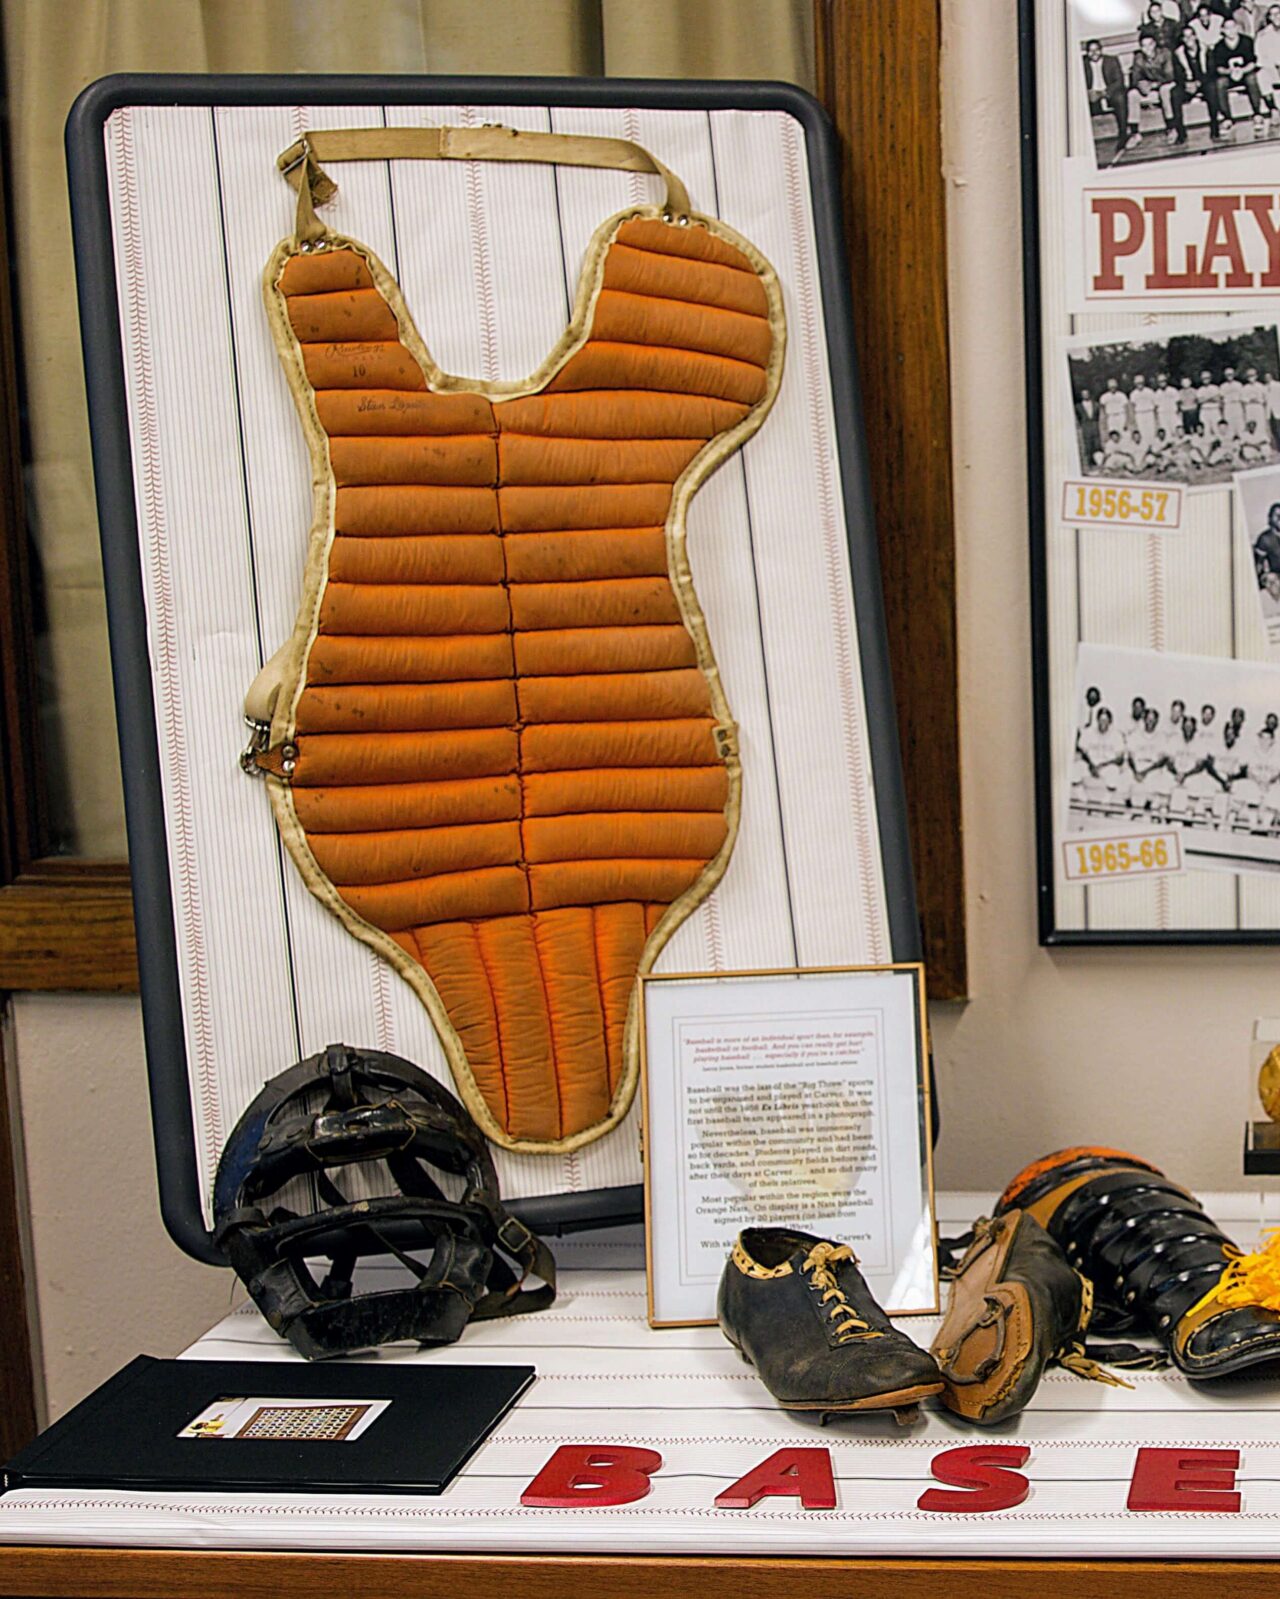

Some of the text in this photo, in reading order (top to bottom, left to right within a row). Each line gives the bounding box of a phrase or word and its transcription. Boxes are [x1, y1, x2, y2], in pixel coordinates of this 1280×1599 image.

[1075, 487, 1168, 522] 1956-57
[1077, 839, 1169, 875] 1965-66
[687, 1085, 722, 1093] Baseball
[848, 1077, 874, 1088] sports
[774, 1091, 802, 1101] played
[724, 1104, 737, 1112] the
[801, 1100, 839, 1110] yearbook
[705, 1116, 742, 1124] baseball
[743, 1114, 764, 1122] team
[766, 1112, 806, 1123] appeared
[760, 1126, 796, 1134] baseball
[816, 1122, 861, 1133] immensely
[691, 1140, 723, 1150] popular
[726, 1138, 751, 1146] within
[768, 1135, 815, 1146] community
[852, 1132, 872, 1140] been
[792, 1145, 821, 1156] played
[690, 1161, 710, 1169] back
[757, 1157, 803, 1168] community
[805, 1155, 829, 1163] fields
[830, 1154, 858, 1162] before
[732, 1170, 752, 1180] days
[763, 1168, 792, 1176] Carver
[810, 1166, 825, 1174] and
[854, 1165, 878, 1174] many
[702, 1195, 721, 1203] Most
[724, 1194, 756, 1204] popular
[758, 1192, 784, 1200] within
[802, 1189, 829, 1200] region
[852, 1187, 866, 1195] the
[696, 1206, 727, 1216] Orange
[768, 1202, 799, 1213] display
[817, 1200, 836, 1208] Nats
[837, 1199, 873, 1207] baseball
[714, 1215, 742, 1225] signed
[744, 1214, 755, 1224] by
[769, 1212, 800, 1222] players
[837, 1209, 856, 1217] from
[701, 1240, 720, 1248] With
[836, 1233, 871, 1241] Carver’s
